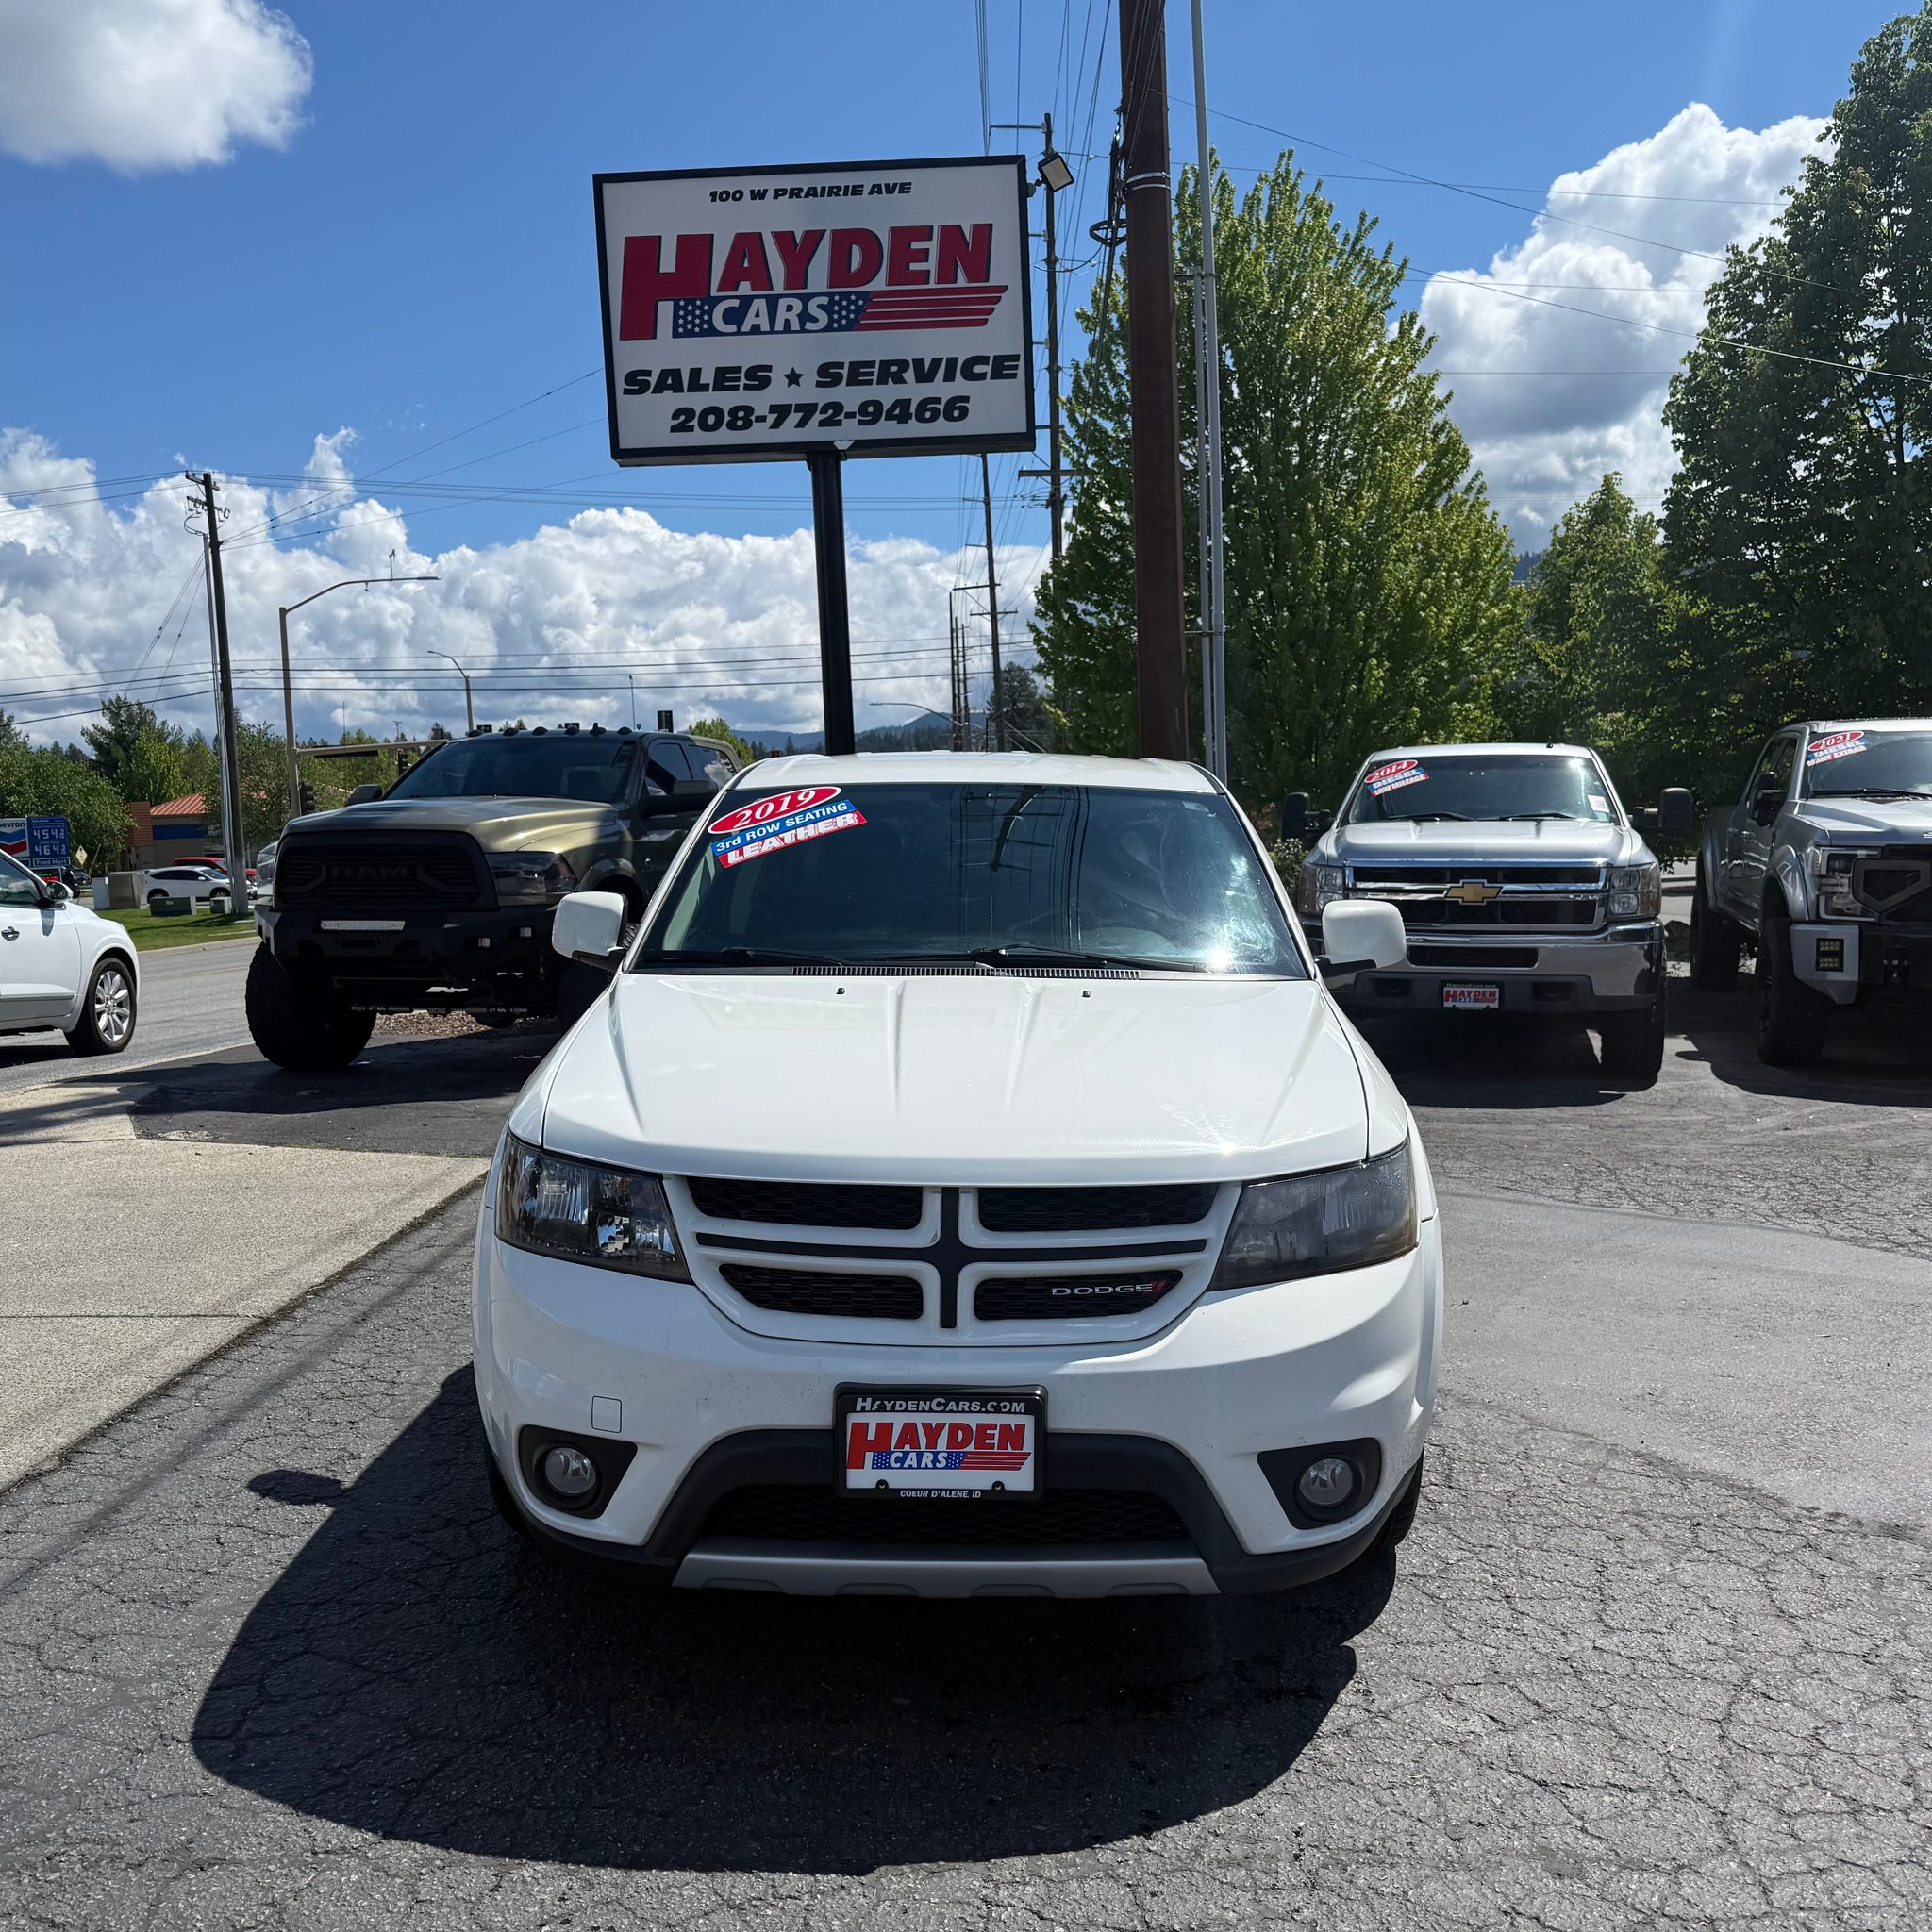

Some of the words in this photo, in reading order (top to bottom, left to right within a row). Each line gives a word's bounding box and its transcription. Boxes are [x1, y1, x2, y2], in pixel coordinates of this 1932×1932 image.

[709, 190, 744, 203] 100
[749, 188, 769, 201] W
[772, 184, 865, 200] PRAIRIE
[868, 181, 913, 196] AVE
[619, 223, 993, 341] HAYDEN
[711, 296, 830, 334] CARS
[623, 364, 774, 395] SALES
[815, 354, 1021, 389] SERVICE
[670, 395, 971, 434] 208-772-9466
[1819, 733, 1851, 750] 2021
[1373, 760, 1408, 777] 2014
[733, 790, 816, 829] 2019
[716, 836, 741, 852] 3rd
[745, 823, 781, 841] ROW
[785, 802, 848, 827] SEATING
[727, 811, 859, 865] LEATHER
[331, 866, 408, 878] RAM
[1444, 990, 1497, 1002] HAYDEN
[1052, 1283, 1154, 1296] DODGE
[846, 1422, 1026, 1470] HAYDEN
[890, 1452, 949, 1469] CARS
[900, 1490, 929, 1498] COEUR
